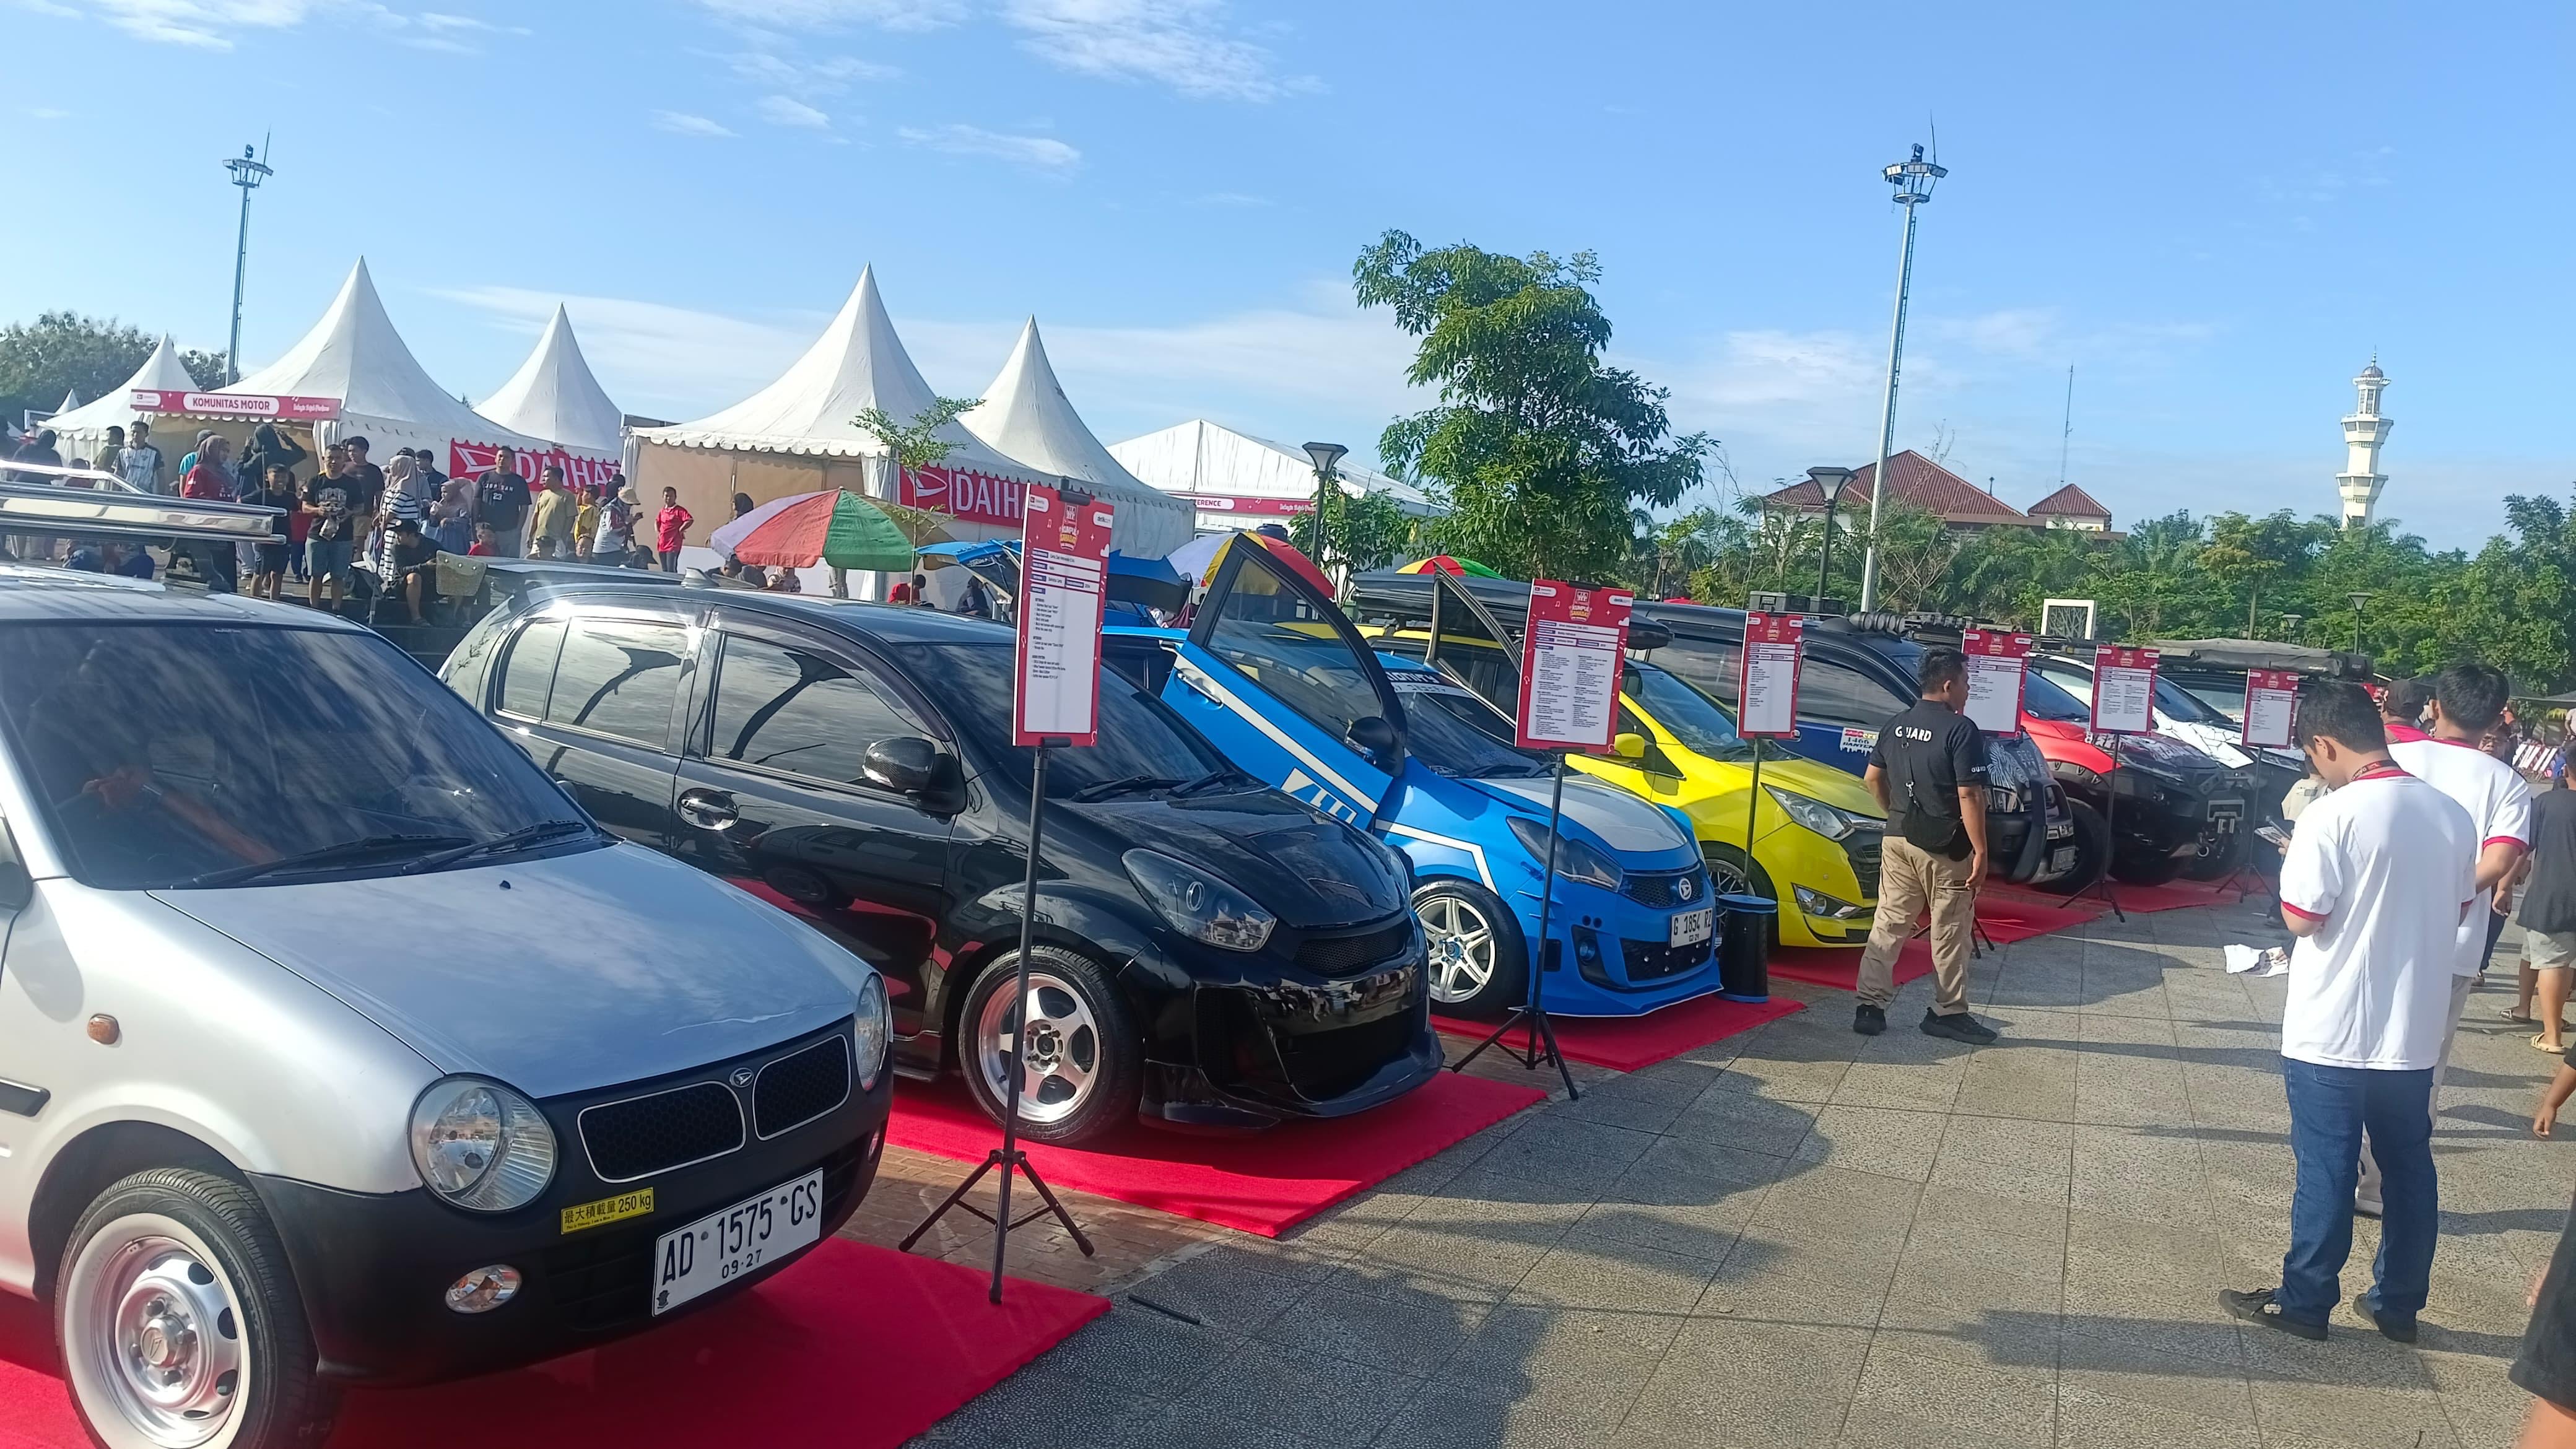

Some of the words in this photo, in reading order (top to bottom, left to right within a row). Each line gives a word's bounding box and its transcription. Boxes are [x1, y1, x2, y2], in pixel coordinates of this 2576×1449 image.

[193, 398, 239, 409] KOMUNITAS
[240, 400, 271, 411] MOTOR
[493, 492, 503, 500] 23
[955, 473, 1024, 520] DAIH
[1196, 499, 1222, 507] ERENCE
[1894, 725, 1933, 742] GUARD
[1673, 917, 1679, 936] G
[1684, 913, 1700, 934] 1854
[1704, 910, 1712, 928] RZ
[564, 1200, 616, 1224] 最大積載量
[618, 1195, 637, 1214] 250
[640, 1194, 651, 1210] kg
[662, 1231, 695, 1286] AD
[718, 1196, 773, 1260] 1575
[790, 1180, 818, 1226] GS
